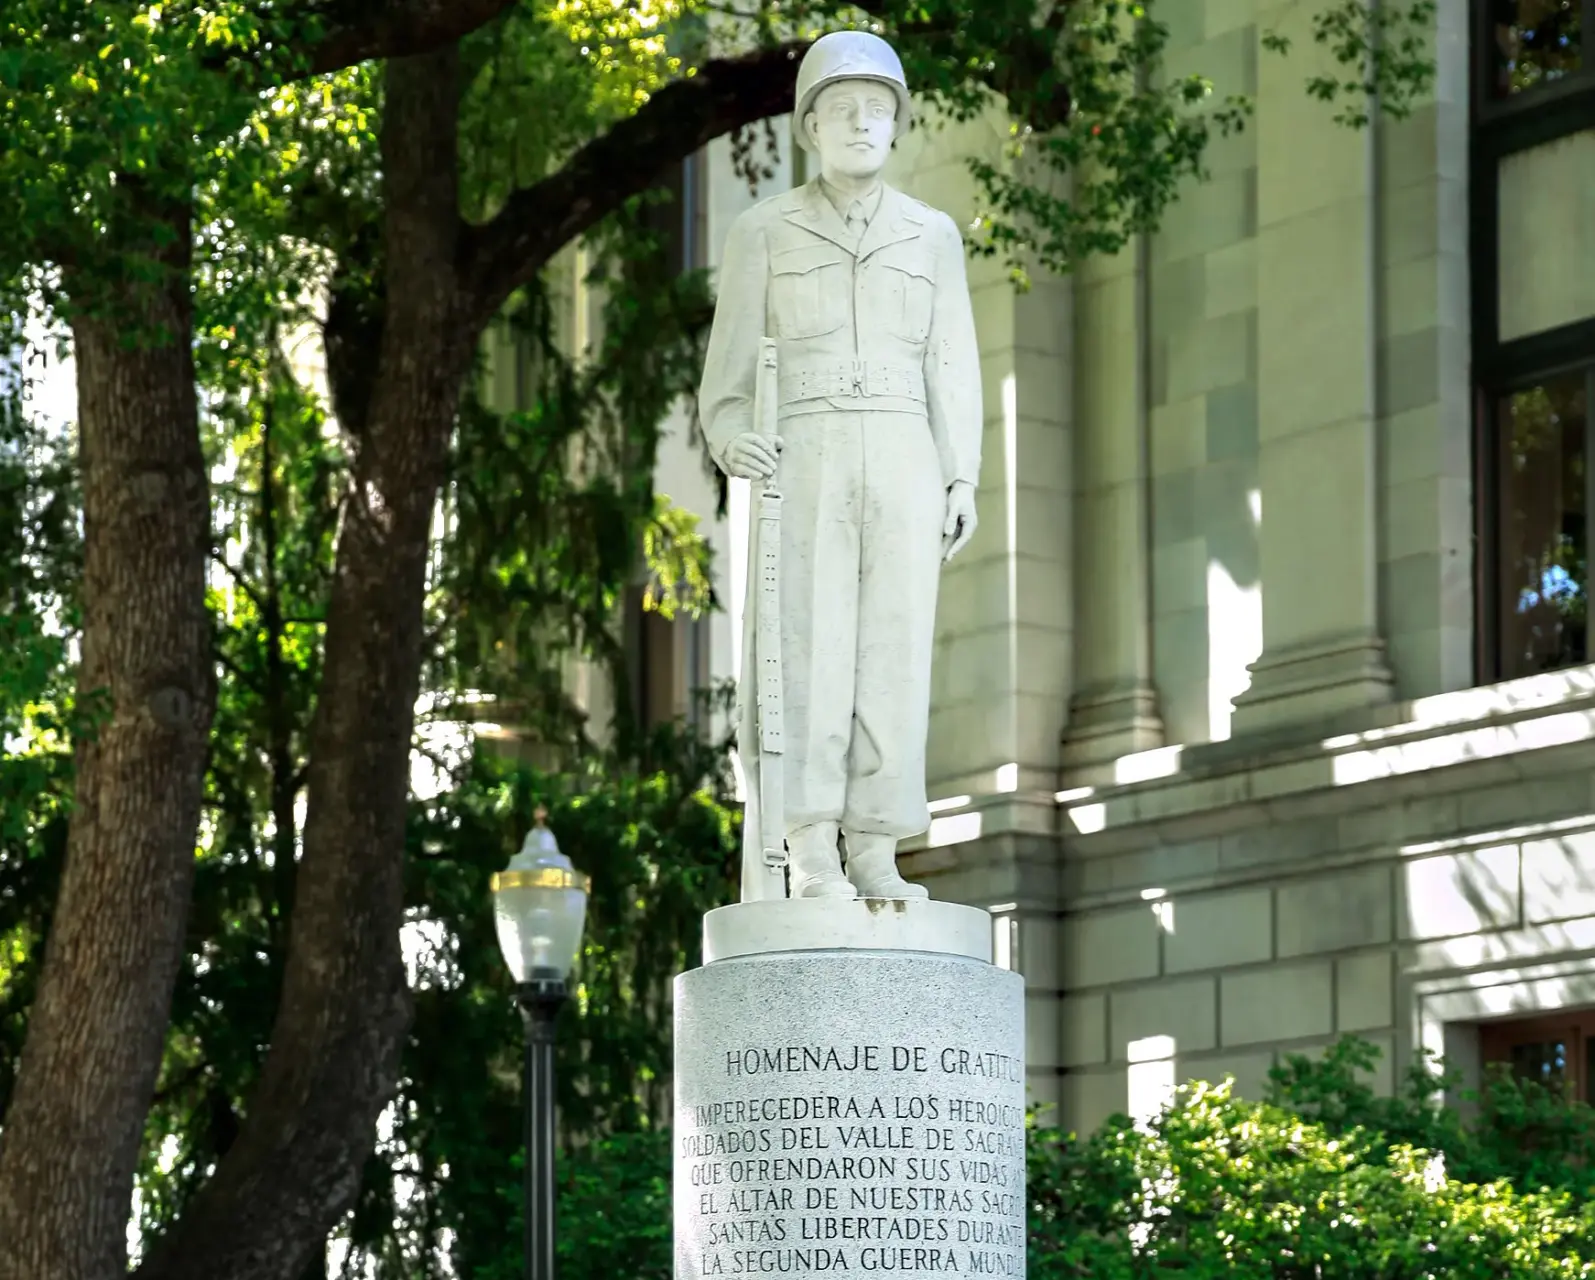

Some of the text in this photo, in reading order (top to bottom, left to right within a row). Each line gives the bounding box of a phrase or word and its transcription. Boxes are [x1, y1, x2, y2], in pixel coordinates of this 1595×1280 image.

[726, 1046, 880, 1077] HOMENAJE
[892, 1046, 928, 1072] DE
[695, 1096, 862, 1127] IMPERECEDERA
[868, 1097, 885, 1119] A
[895, 1096, 939, 1120] LOS
[682, 1127, 772, 1159] SOLDADOS
[782, 1126, 829, 1150] DEL
[836, 1126, 914, 1150] VALLE
[926, 1128, 957, 1152] DE
[691, 1162, 723, 1187] QUE
[729, 1157, 897, 1183] OFRENDARON
[906, 1158, 950, 1182] SUS
[960, 1160, 1008, 1187] VIDAS
[700, 1195, 718, 1215] EL
[727, 1188, 793, 1212] ALTAR
[806, 1188, 838, 1210] DE
[850, 1187, 974, 1212] NUESTRAS
[709, 1217, 787, 1244] SANTAS
[801, 1217, 949, 1241] LIBERTADES
[702, 1252, 724, 1276] LA
[733, 1249, 849, 1273] SEGUNDA
[860, 1248, 959, 1272] GUERRA
